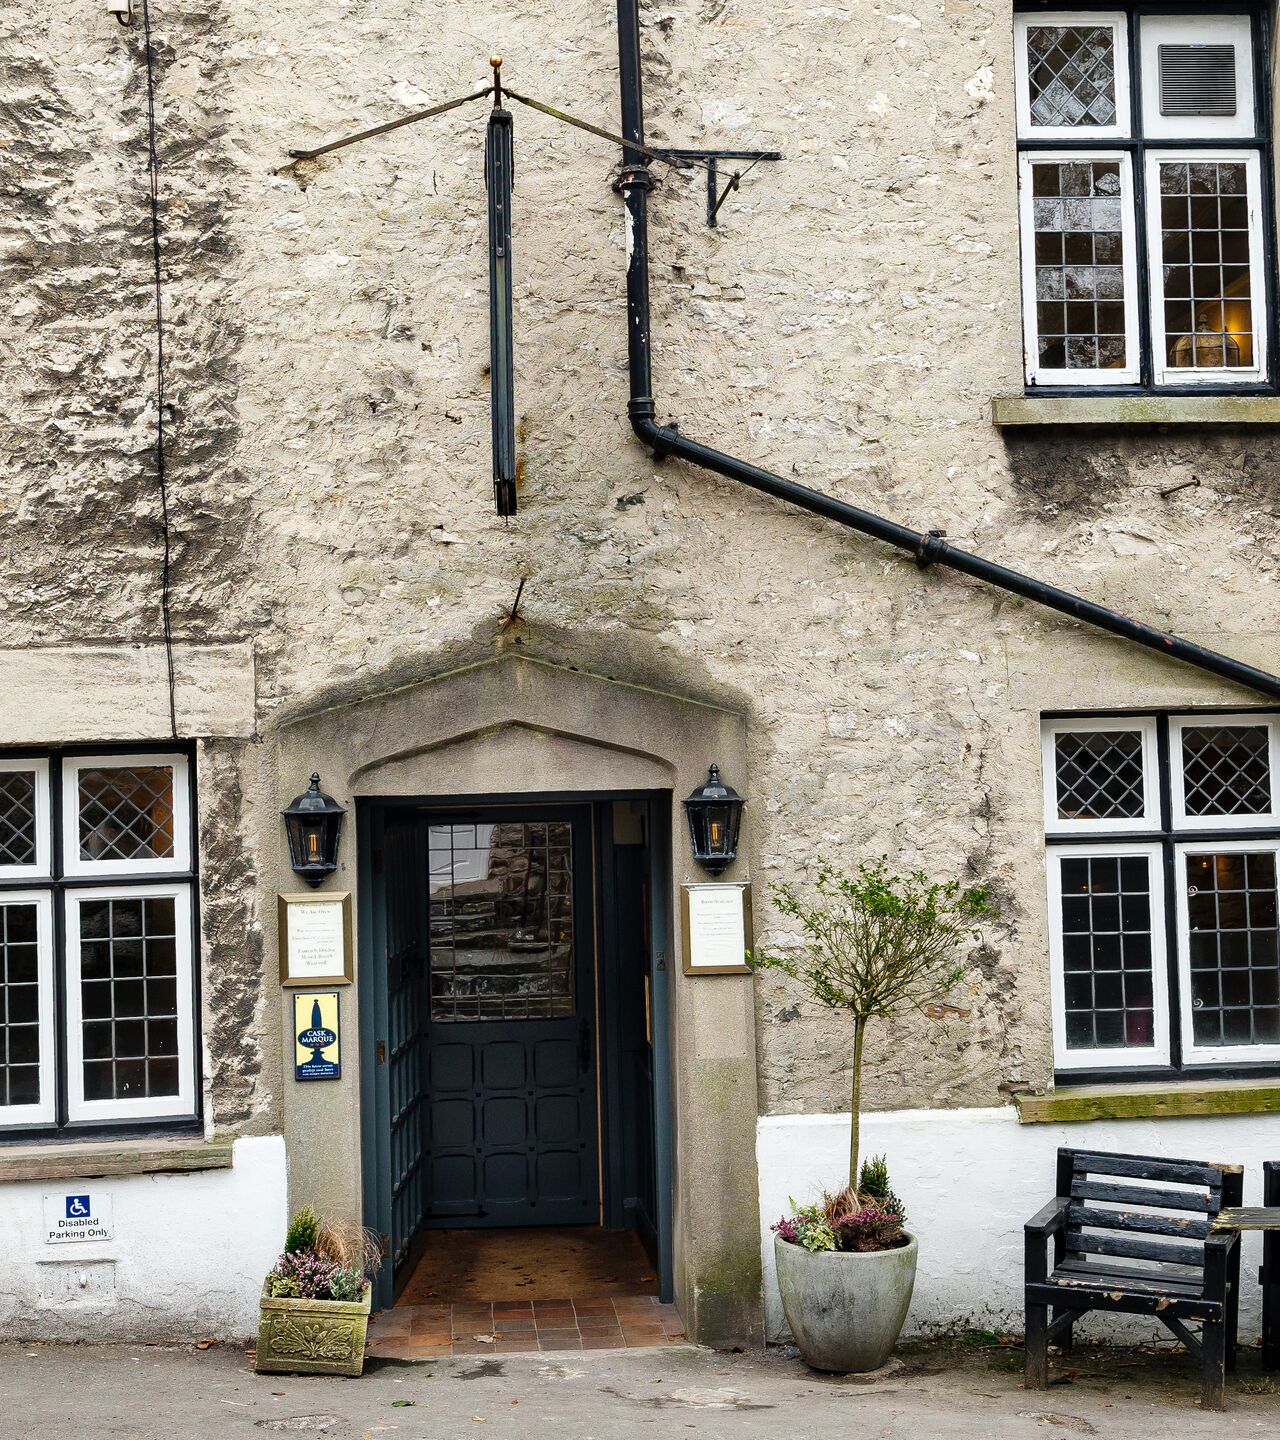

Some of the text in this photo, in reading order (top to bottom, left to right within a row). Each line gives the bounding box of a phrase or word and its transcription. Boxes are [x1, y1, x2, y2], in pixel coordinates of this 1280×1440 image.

[58, 1218, 99, 1228] Disabled
[49, 1228, 108, 1239] Parking Only
